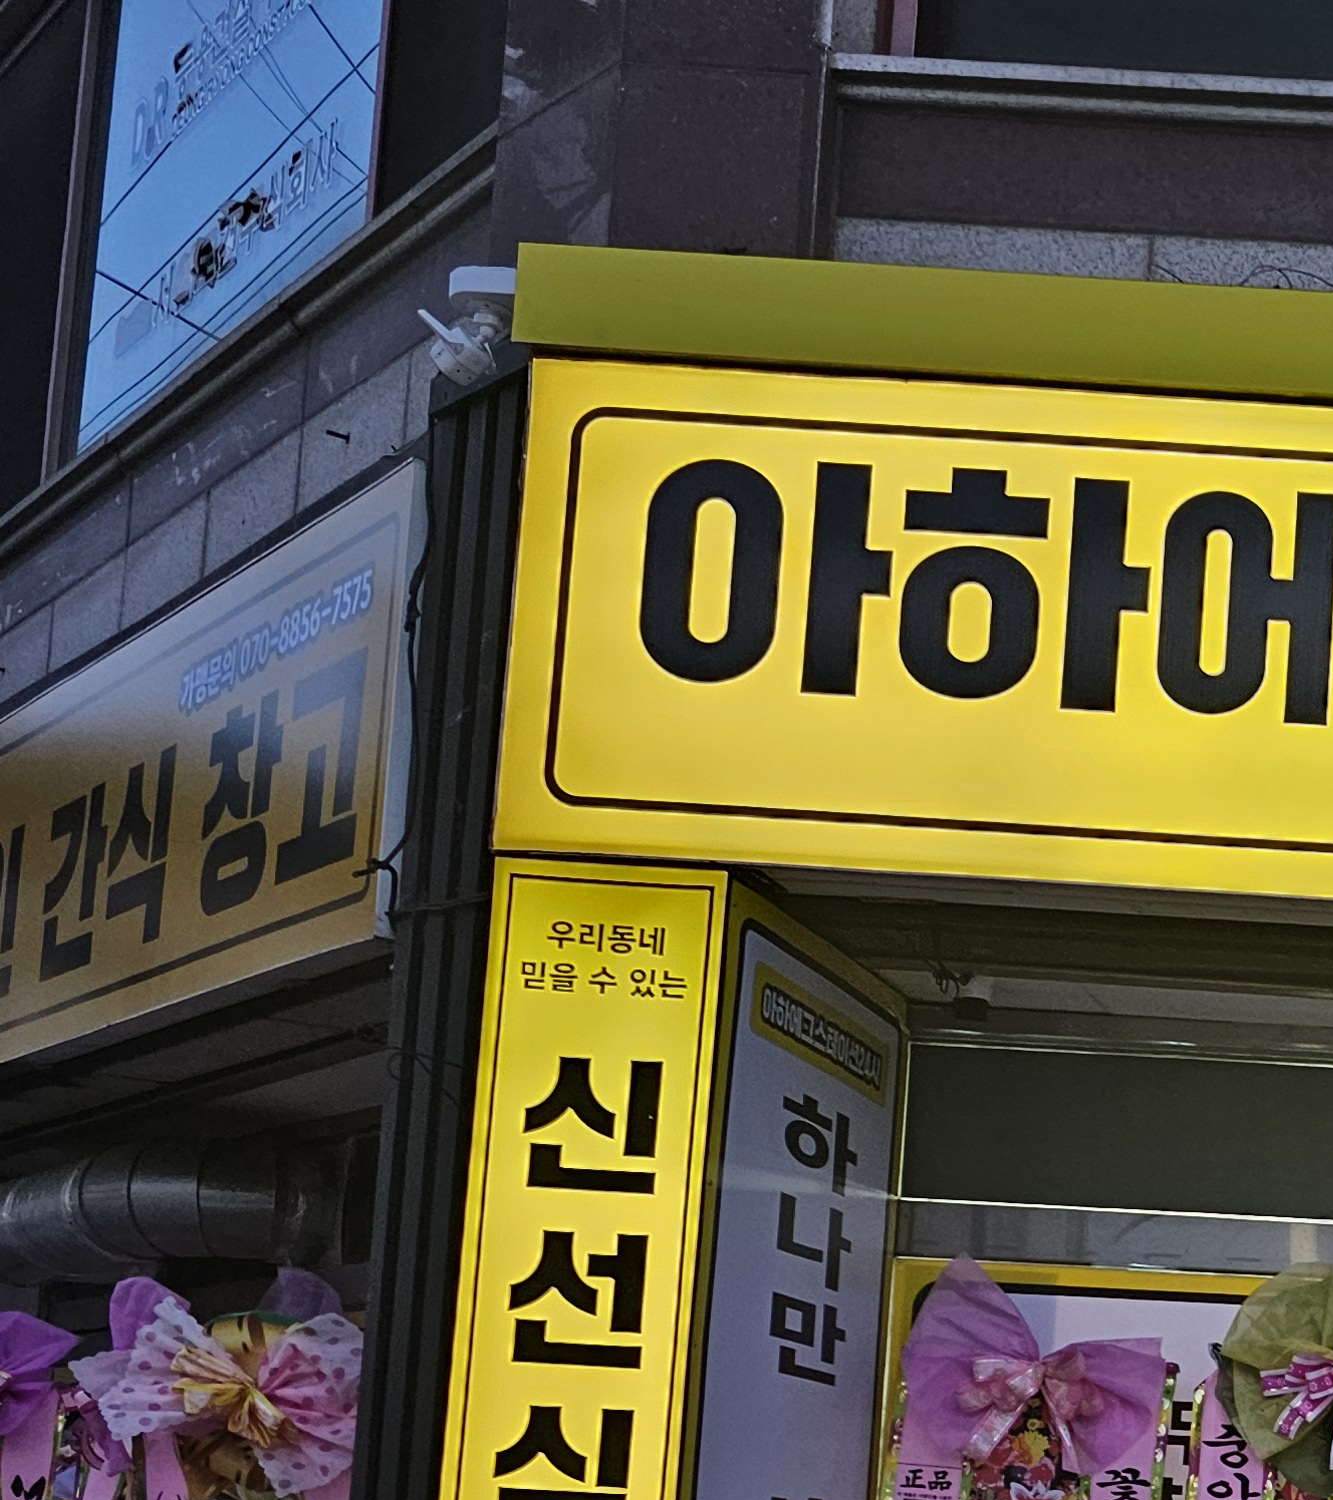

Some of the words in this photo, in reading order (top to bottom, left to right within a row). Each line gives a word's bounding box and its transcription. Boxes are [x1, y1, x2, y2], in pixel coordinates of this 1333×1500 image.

[239, 568, 373, 678] 070-8856-7575
[40, 743, 177, 982] 간식
[200, 646, 369, 917] 창고
[520, 960, 578, 993] 믿을
[588, 966, 619, 997] 수
[629, 967, 689, 1000] 있는
[546, 921, 666, 957] 우리동네
[768, 1091, 858, 1387] 하나만
